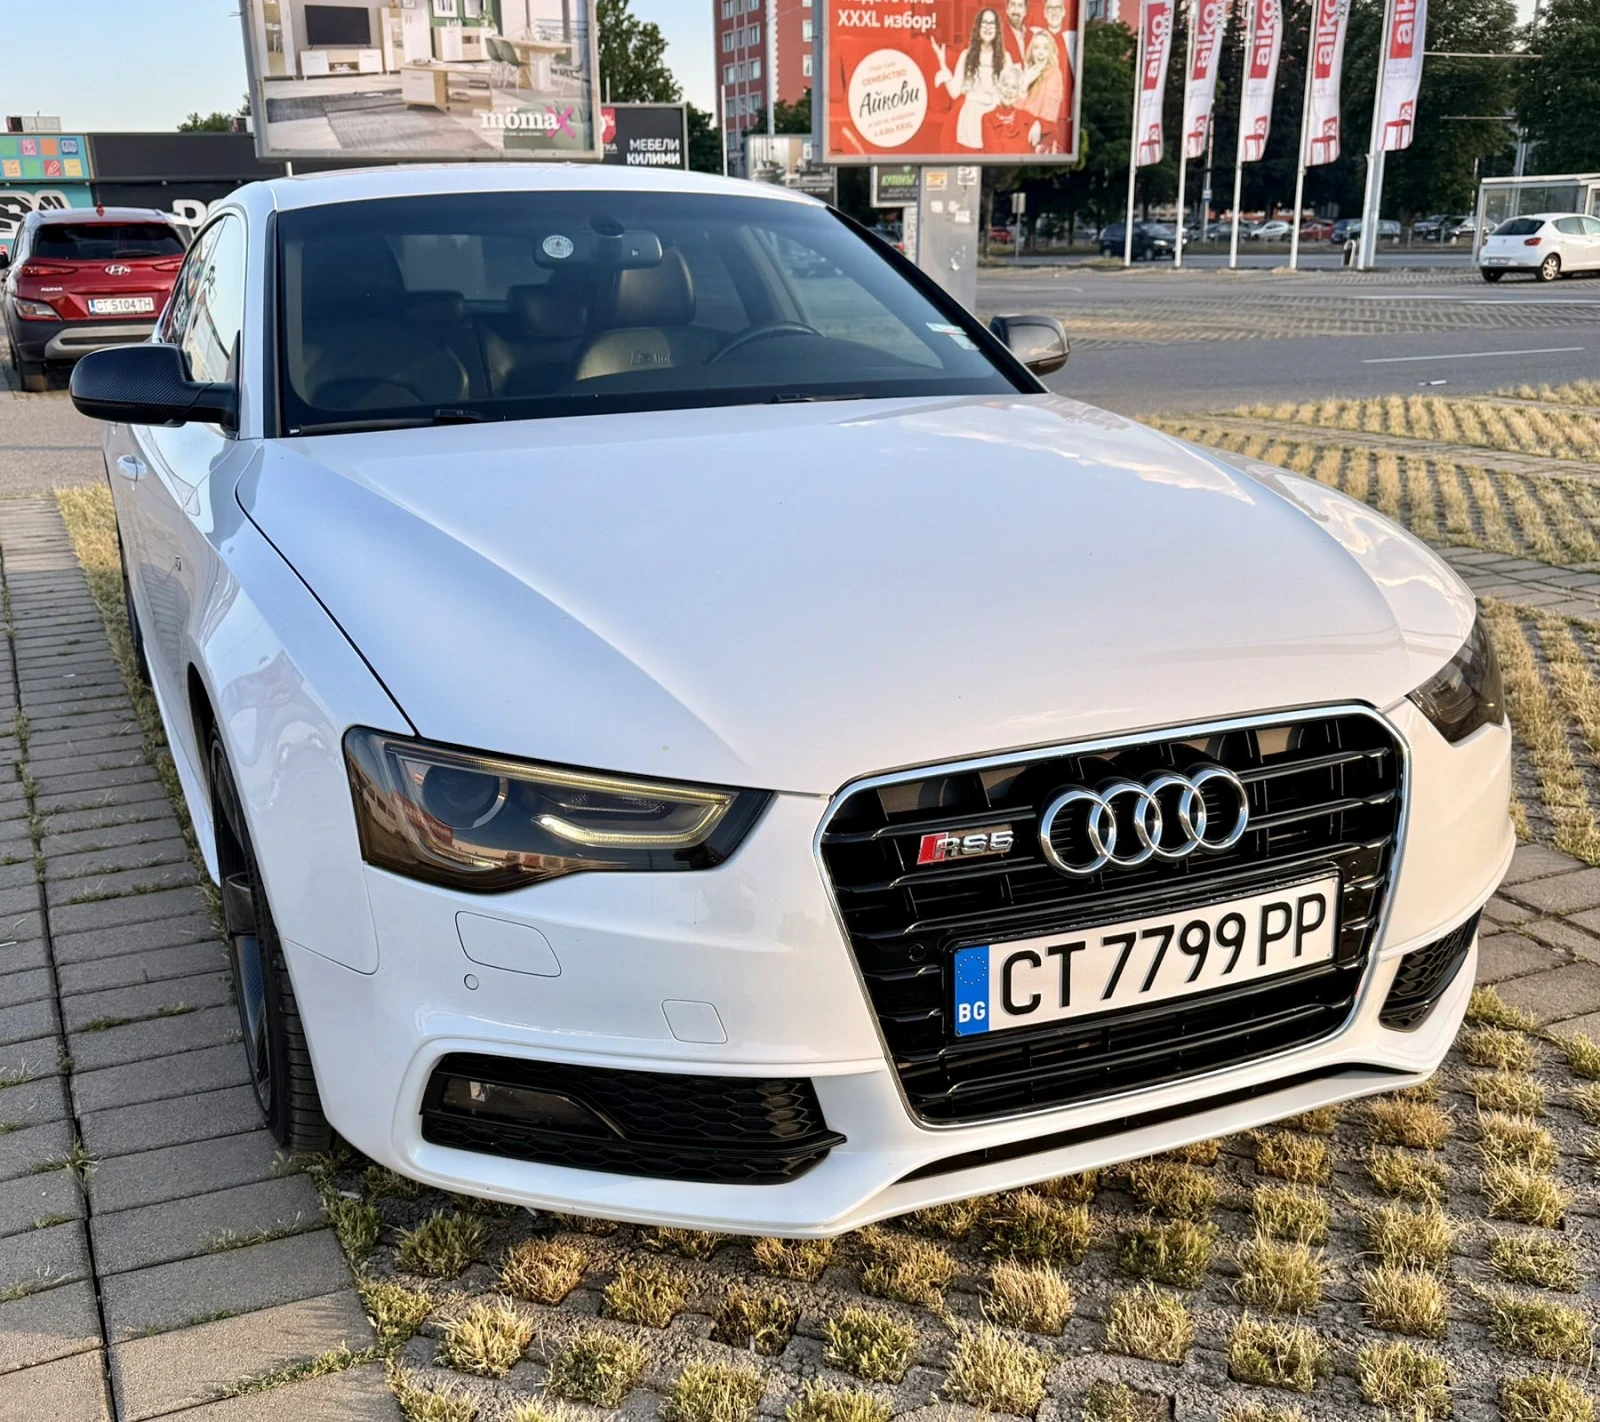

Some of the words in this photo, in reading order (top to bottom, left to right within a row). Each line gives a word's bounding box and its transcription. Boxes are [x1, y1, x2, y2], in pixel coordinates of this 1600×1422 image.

[837, 9, 881, 28] XXXL
[884, 10, 937, 33] избор!
[1146, 15, 1163, 78] aiko
[1197, 3, 1215, 68] aiko
[859, 80, 920, 118] Айкови
[629, 138, 680, 151] МЕБЕЛИ
[626, 152, 681, 165] КИЛИМИ
[96, 301, 110, 311] CT
[112, 300, 136, 311] 5104
[139, 299, 152, 309] TH
[934, 830, 1014, 857] RS5
[1001, 940, 1086, 1017] CT
[1101, 911, 1246, 1000] 7799
[1257, 892, 1328, 967] PP
[958, 1000, 986, 1023] BG
